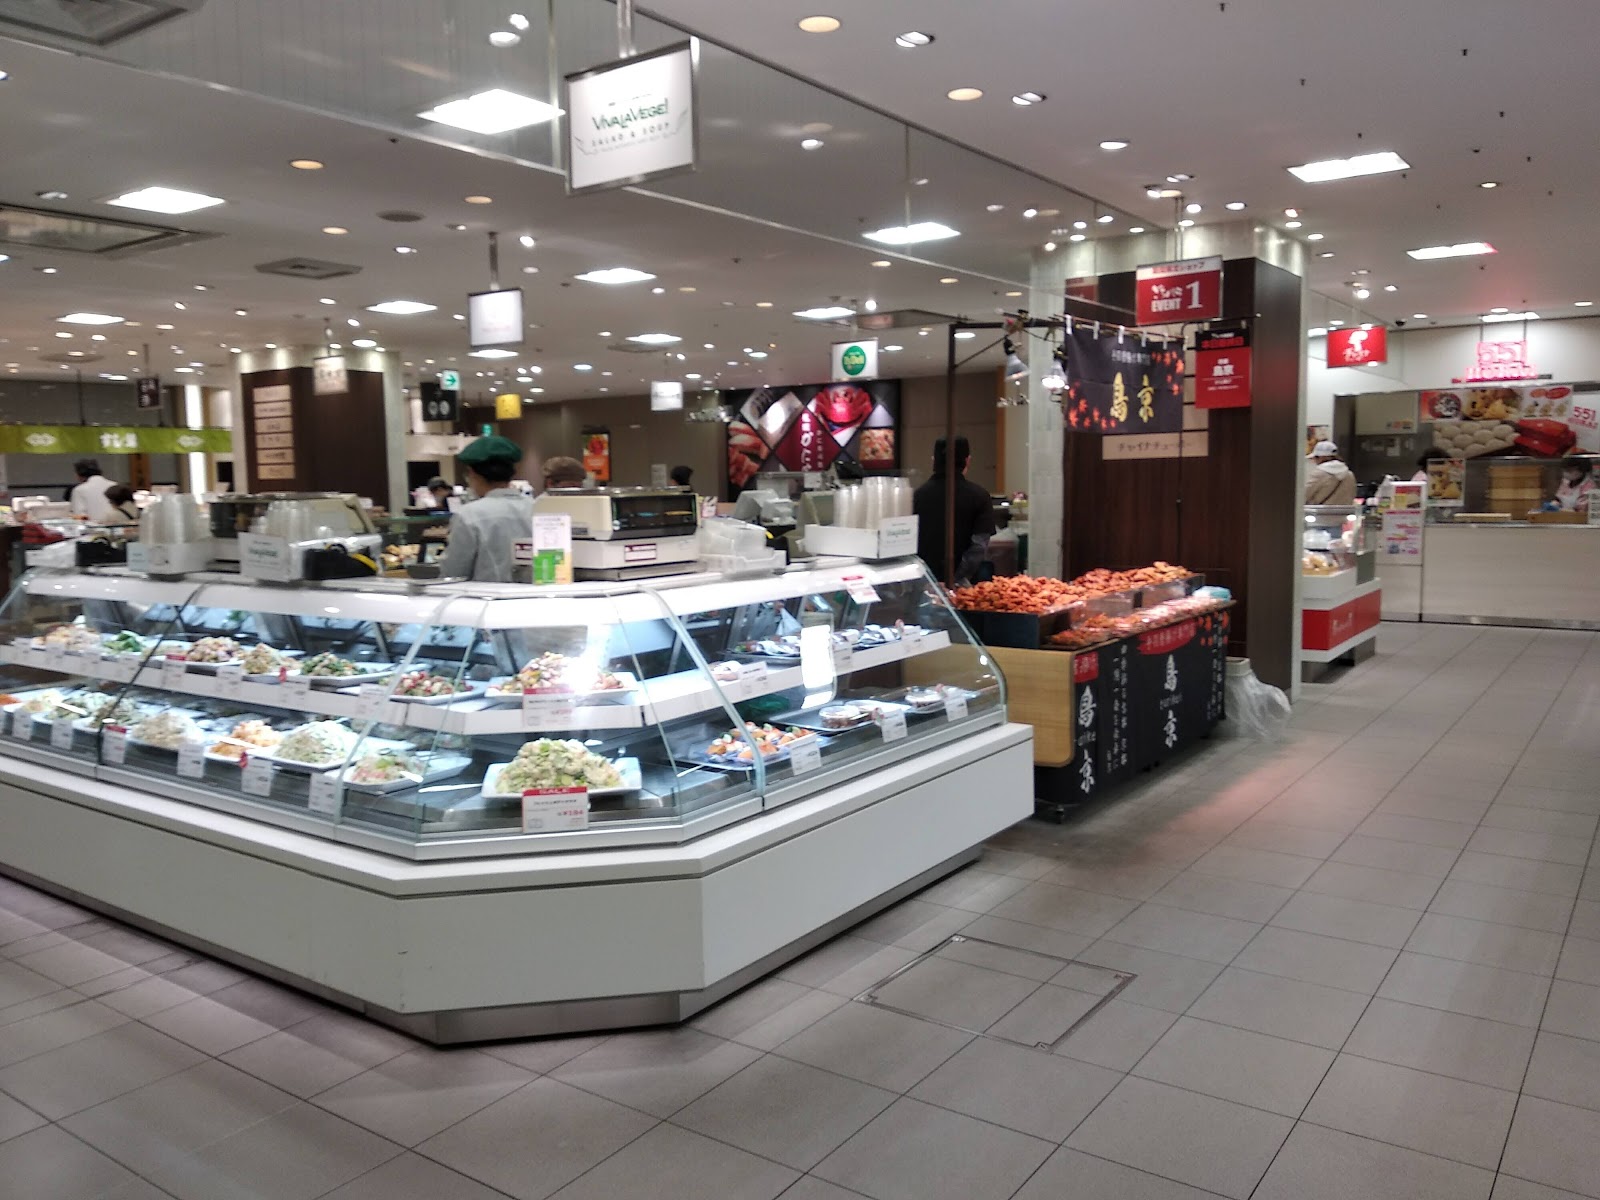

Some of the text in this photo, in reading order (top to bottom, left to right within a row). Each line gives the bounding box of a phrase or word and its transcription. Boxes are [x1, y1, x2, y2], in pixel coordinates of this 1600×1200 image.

[1150, 298, 1182, 313] EVENT
[1186, 280, 1204, 310] 1
[1478, 341, 1527, 365] 551
[1574, 406, 1597, 422] 551
